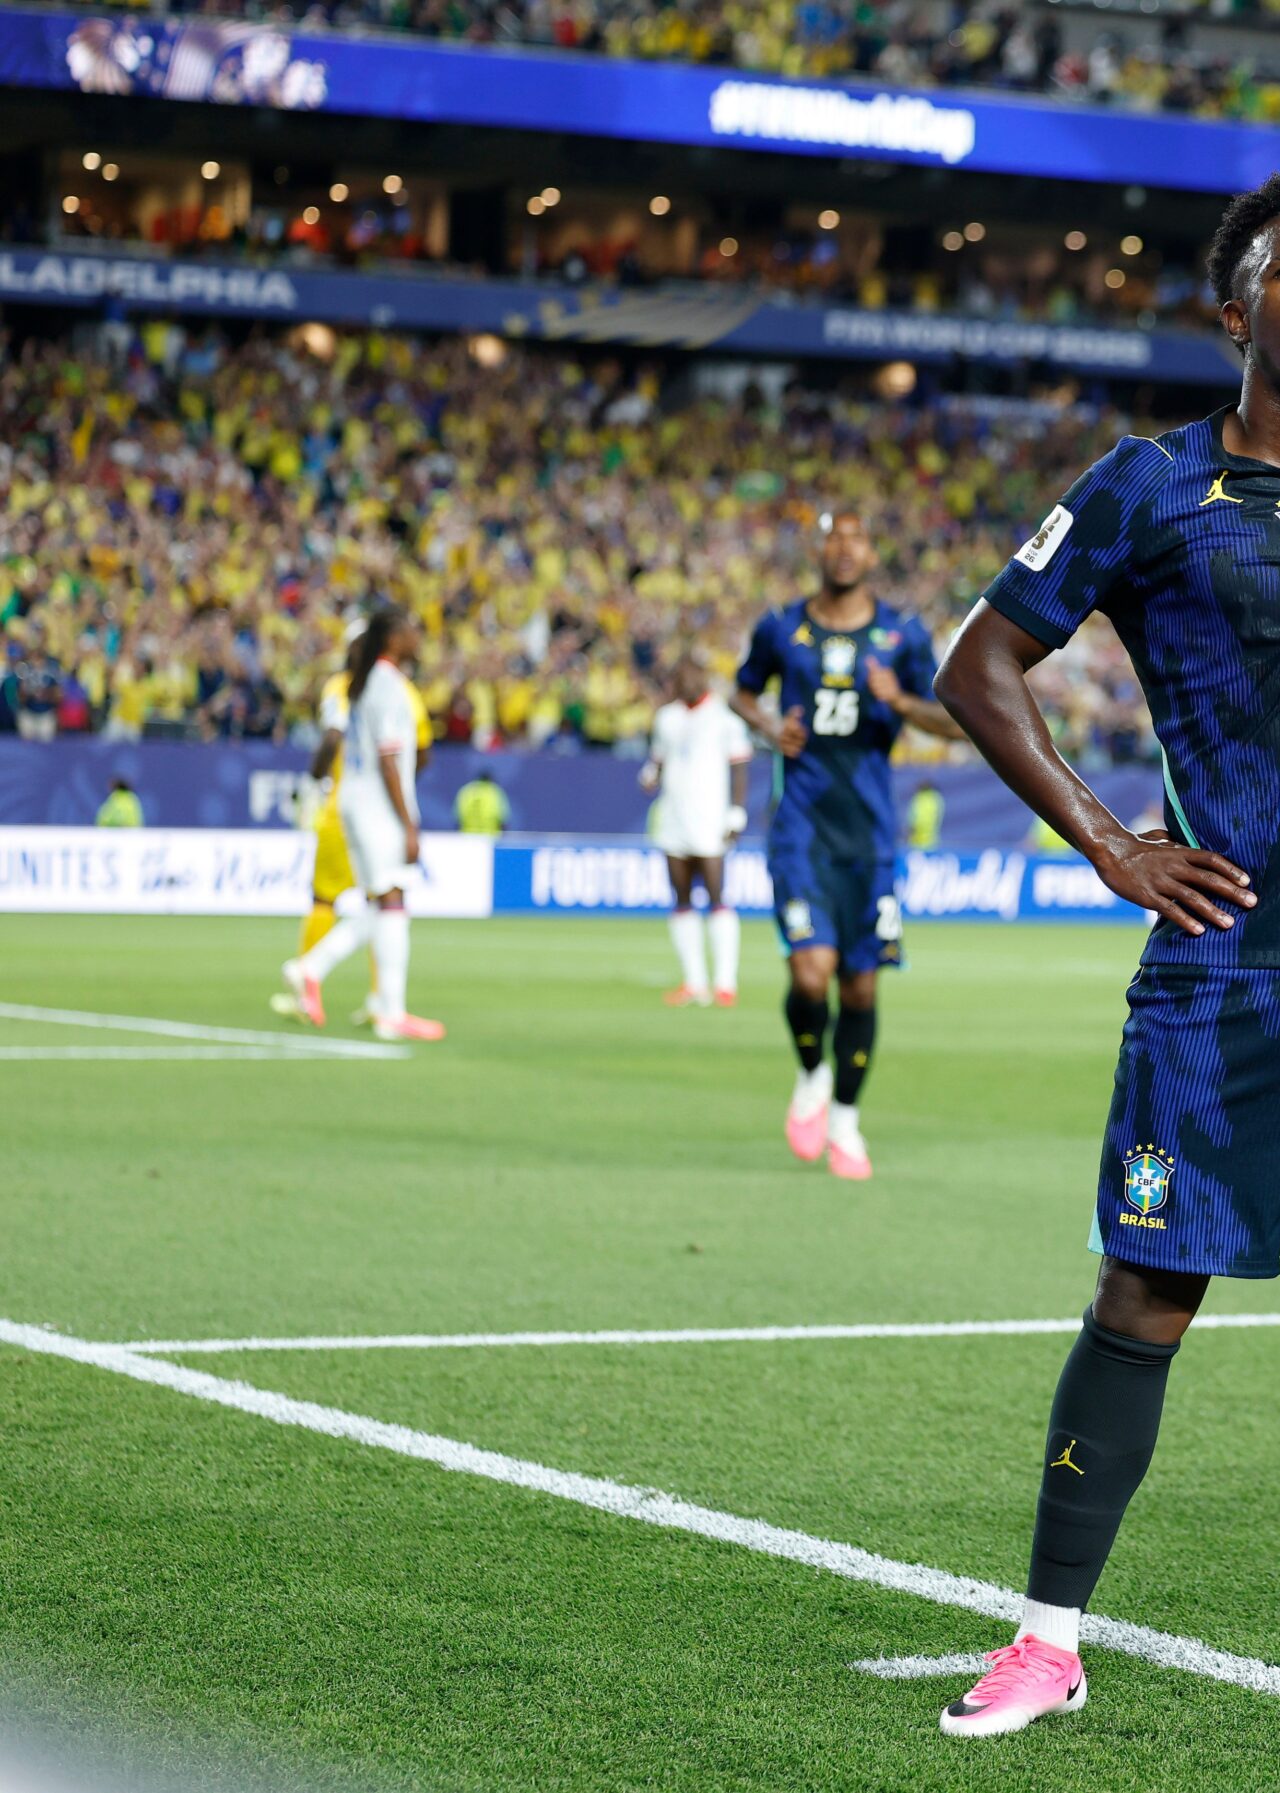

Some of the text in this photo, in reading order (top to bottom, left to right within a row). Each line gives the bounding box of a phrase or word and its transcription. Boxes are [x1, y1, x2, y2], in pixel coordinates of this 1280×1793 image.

[1024, 552, 1036, 563] 26
[1137, 1177, 1155, 1187] CBF
[1119, 1212, 1167, 1230] BRASIL
